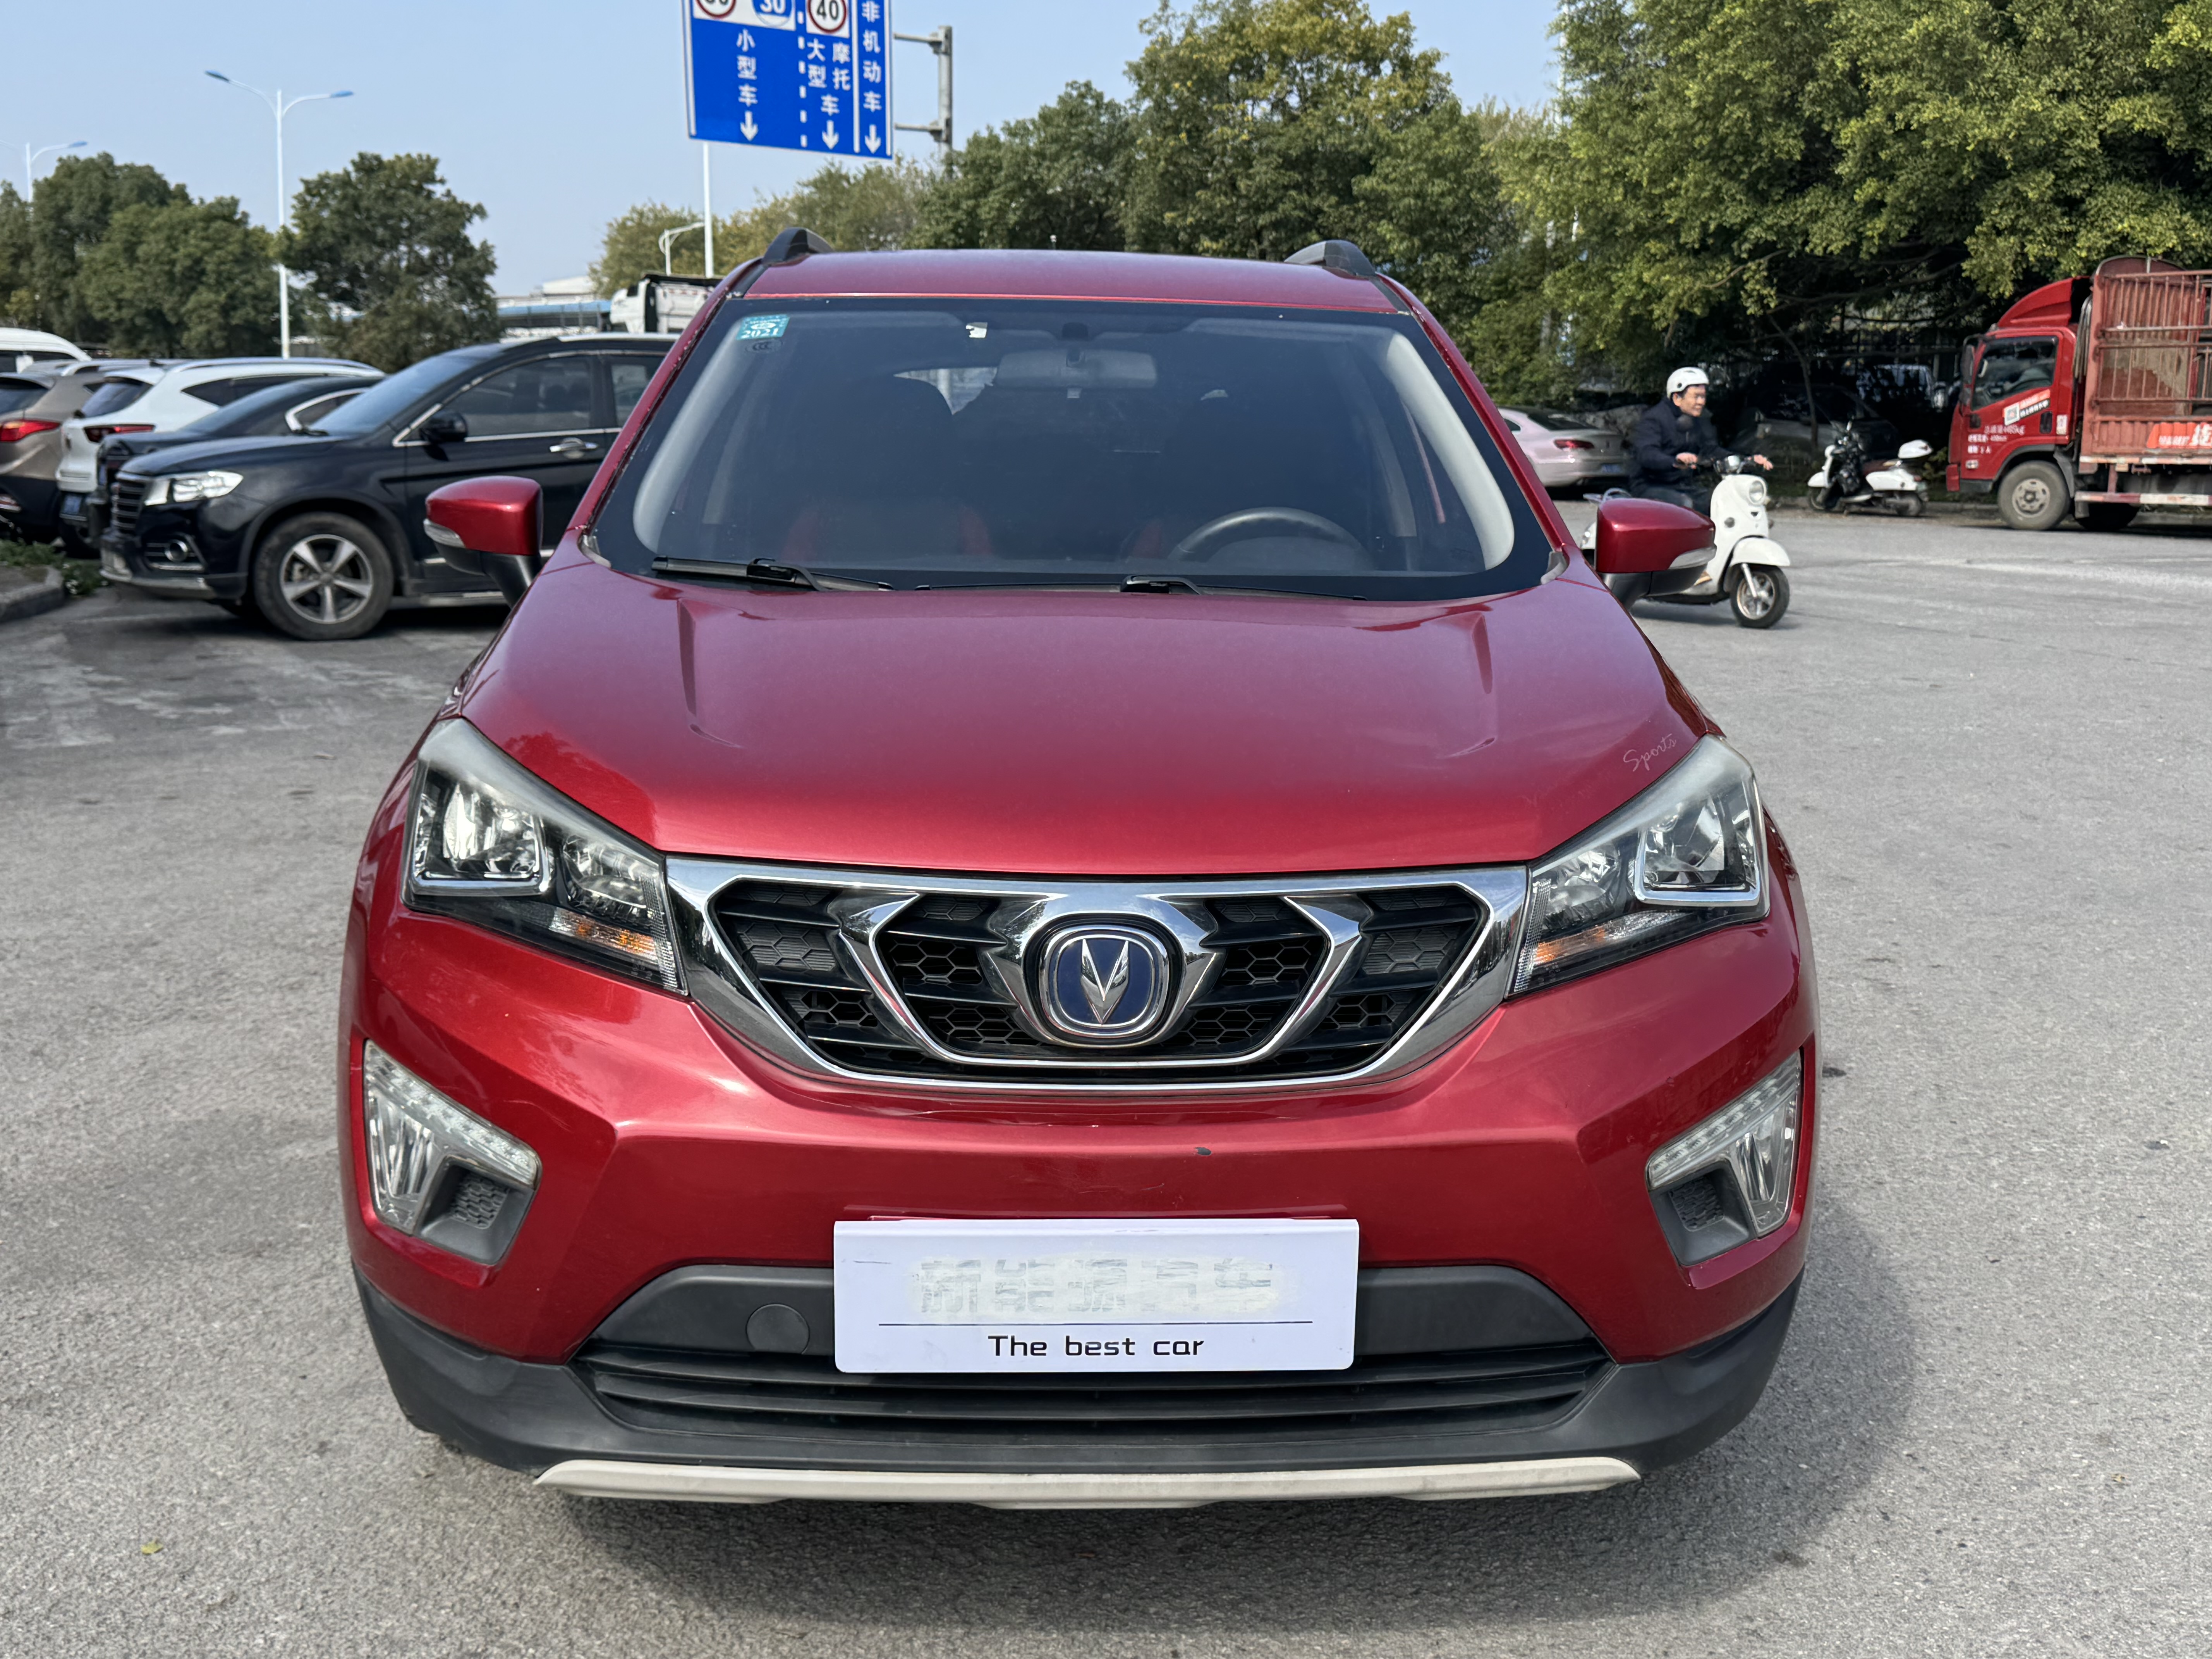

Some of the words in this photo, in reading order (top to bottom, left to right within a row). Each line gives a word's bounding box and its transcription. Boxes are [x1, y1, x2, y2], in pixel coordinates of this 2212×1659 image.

[816, 0, 839, 20] 40
[736, 28, 758, 106] 小型车
[807, 38, 827, 89] 大型
[832, 42, 851, 91] 摩托
[861, 0, 882, 113] 非机动车
[820, 94, 840, 116] 车
[740, 328, 779, 338] 2021
[1623, 733, 1676, 772] Sports
[988, 1335, 1047, 1356] The
[1065, 1335, 1135, 1356] best
[1153, 1340, 1204, 1355] car
